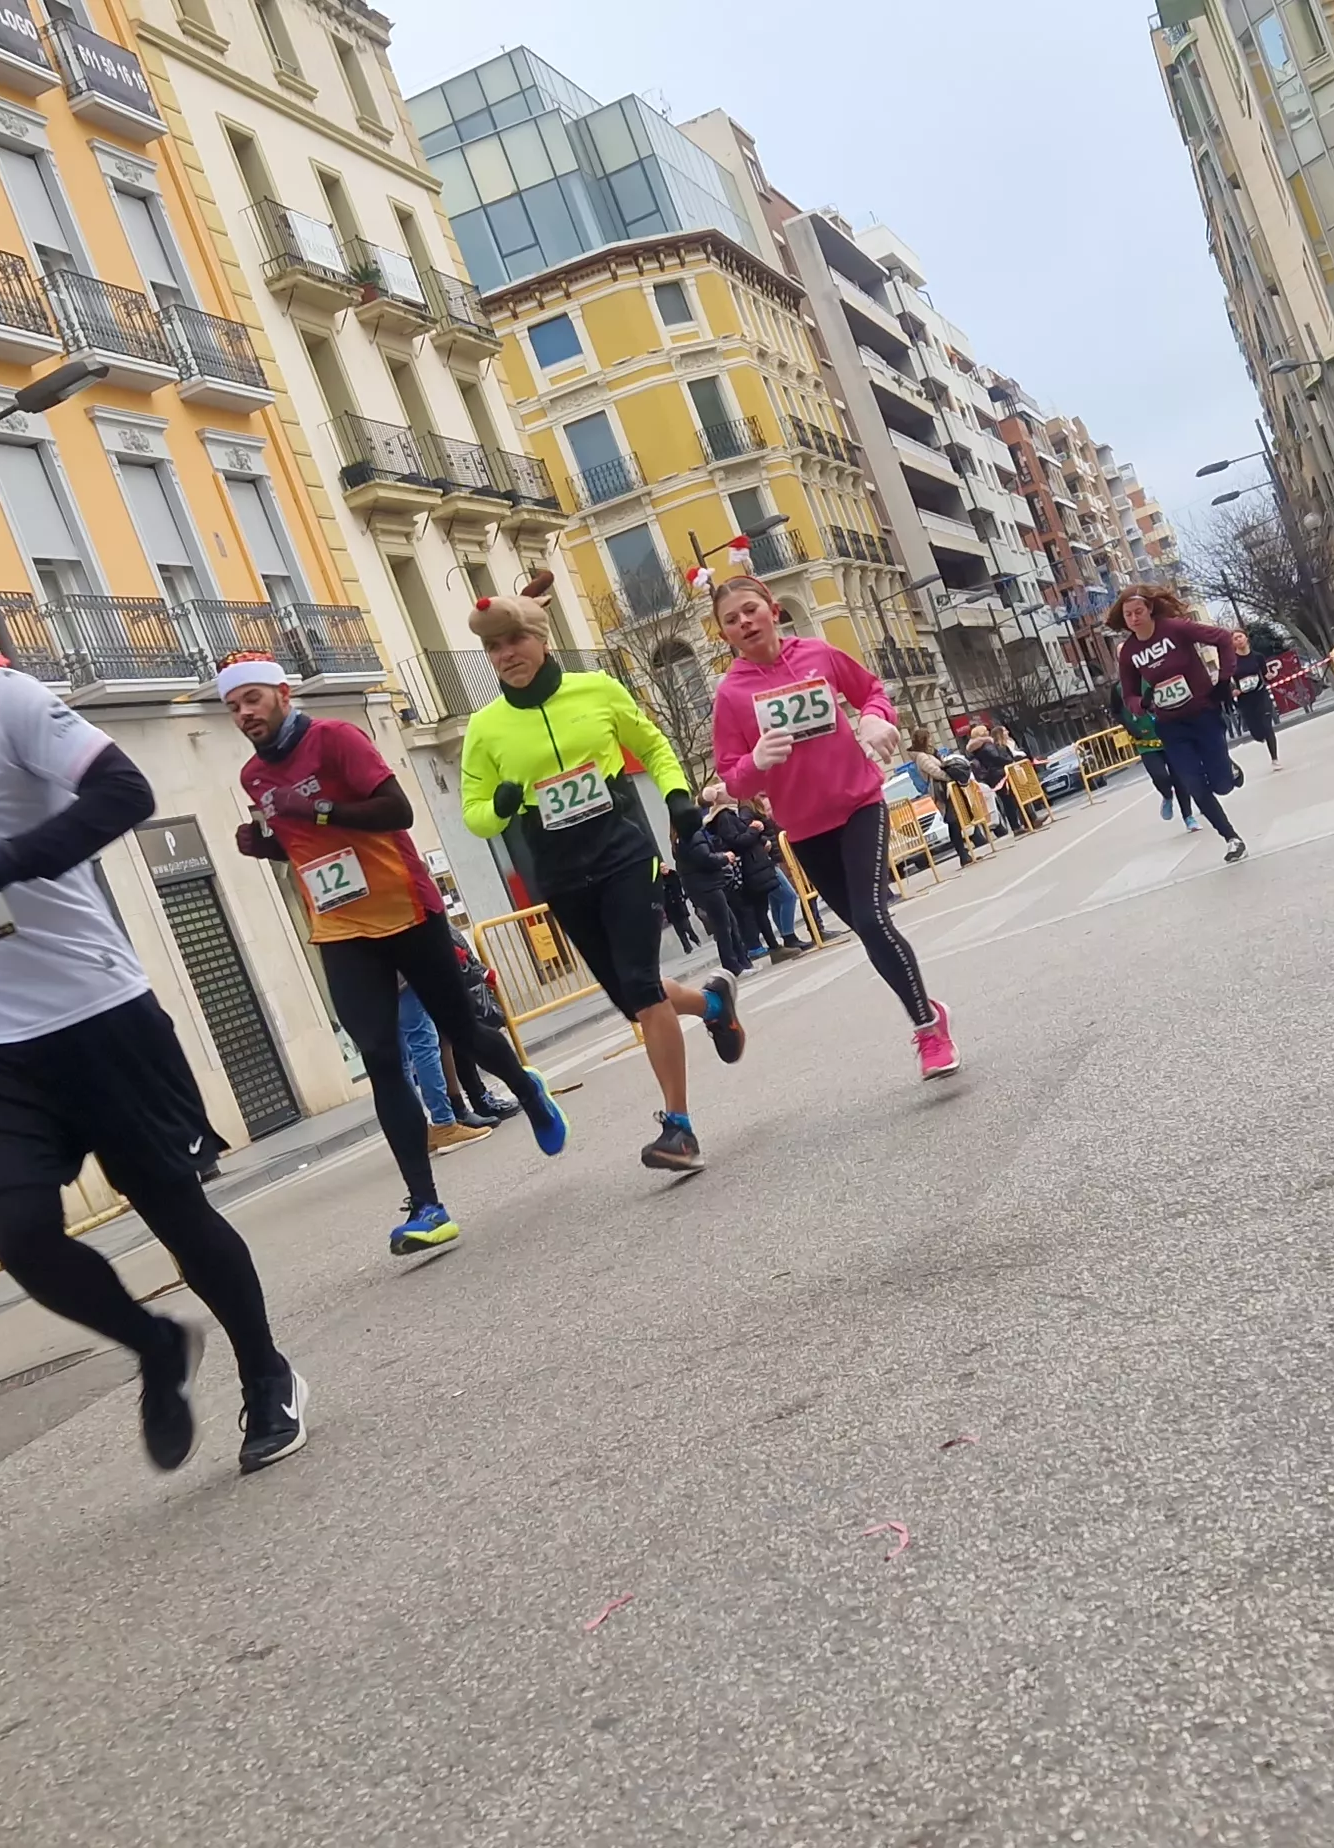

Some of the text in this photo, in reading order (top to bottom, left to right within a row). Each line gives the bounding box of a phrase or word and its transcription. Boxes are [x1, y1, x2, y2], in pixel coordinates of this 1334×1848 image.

[78, 44, 148, 93] 611 59 16 16
[1131, 637, 1176, 669] NASA
[767, 689, 830, 729] 325
[1154, 682, 1187, 704] 245
[546, 773, 603, 814] 322
[316, 862, 351, 895] 12
